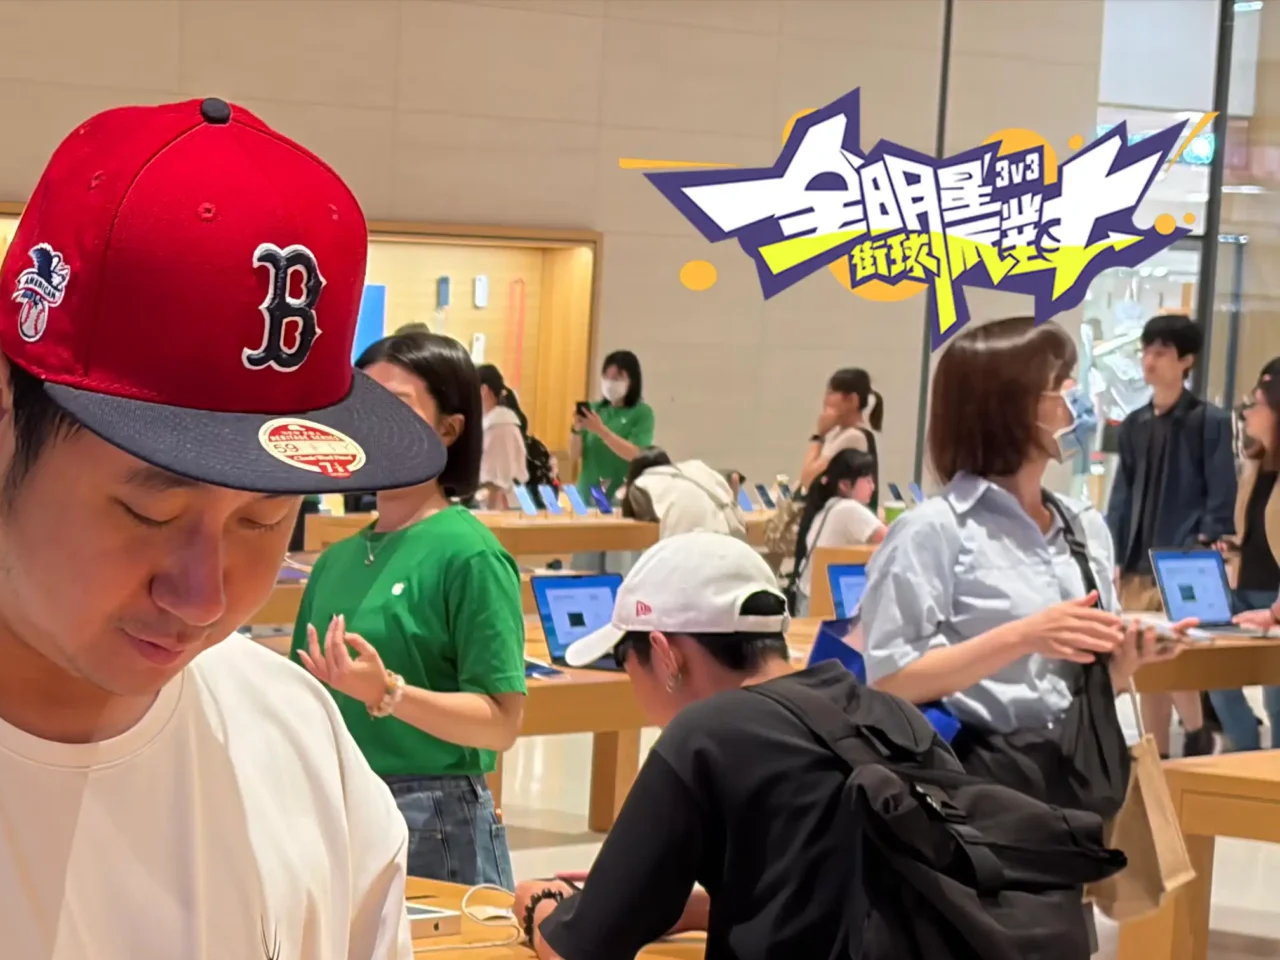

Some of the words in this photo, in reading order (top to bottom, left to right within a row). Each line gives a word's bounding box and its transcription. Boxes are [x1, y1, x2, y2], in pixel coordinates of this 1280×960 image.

[24, 275, 57, 300] AMERICAN
[241, 243, 327, 372] B
[273, 443, 299, 454] 59
